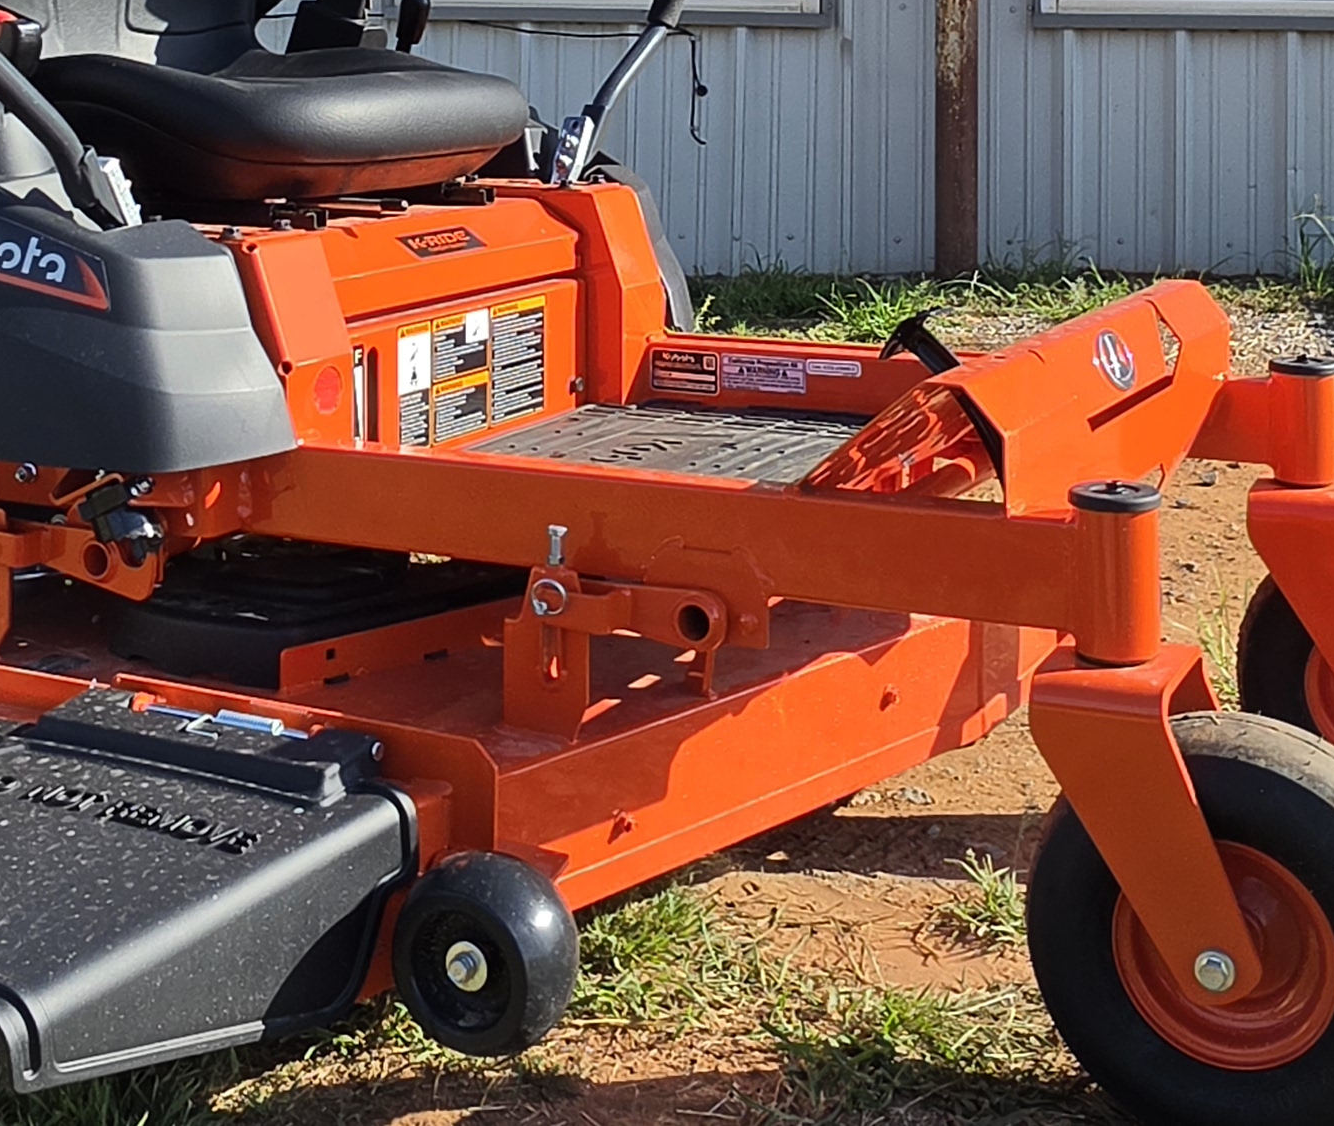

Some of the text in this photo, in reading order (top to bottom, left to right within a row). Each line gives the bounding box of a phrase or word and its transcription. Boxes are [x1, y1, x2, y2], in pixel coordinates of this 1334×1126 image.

[407, 230, 470, 250] K-RIDE
[354, 348, 364, 363] F
[17, 784, 109, 812] NOT
[94, 799, 262, 856] REMOVE
